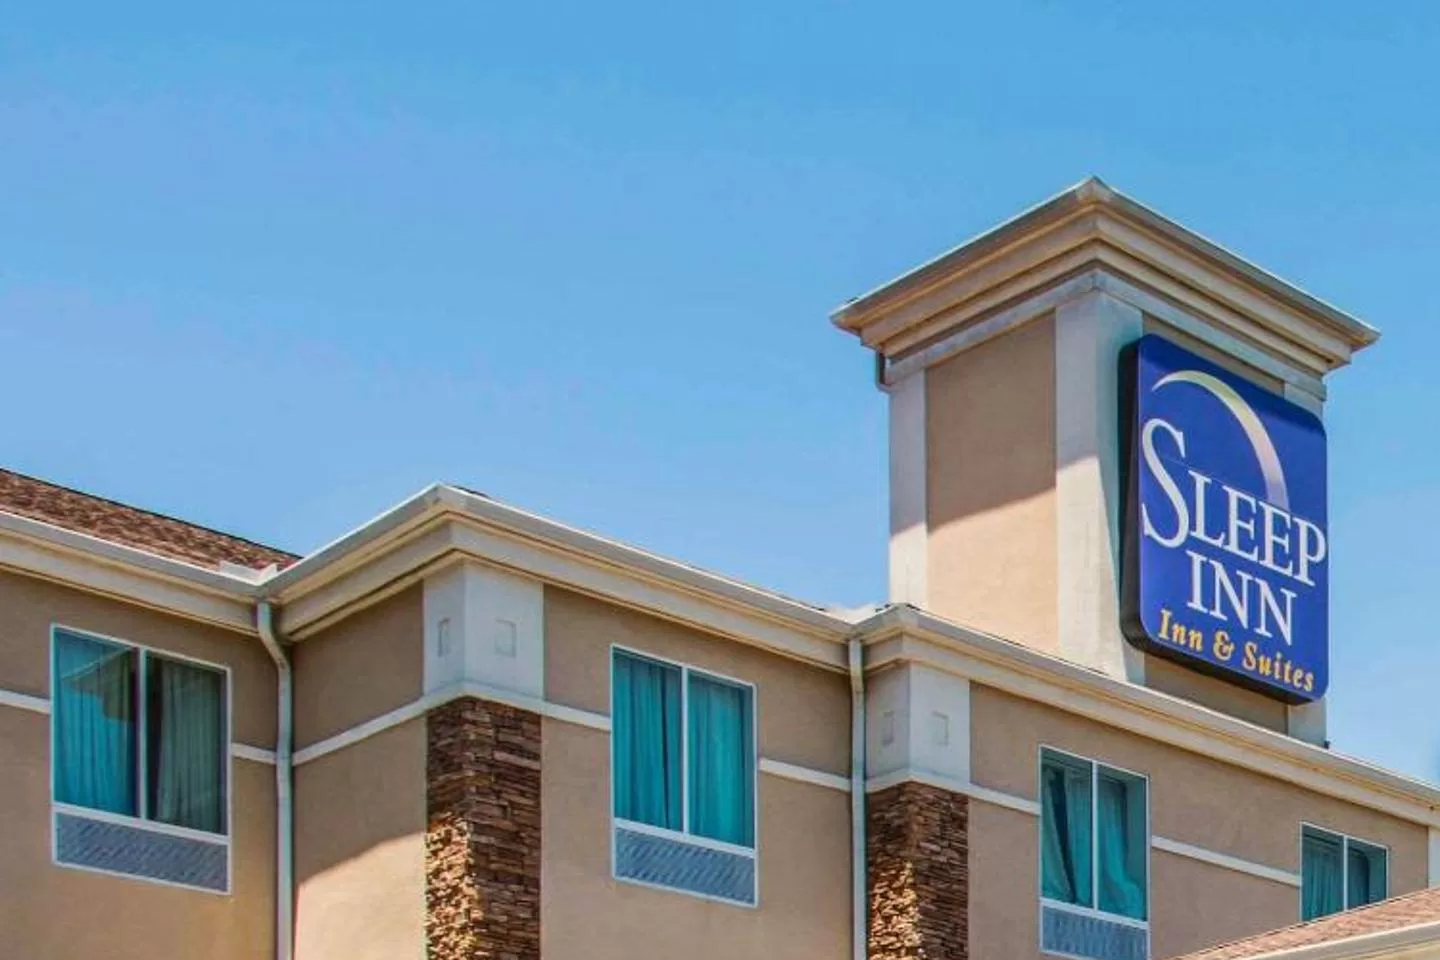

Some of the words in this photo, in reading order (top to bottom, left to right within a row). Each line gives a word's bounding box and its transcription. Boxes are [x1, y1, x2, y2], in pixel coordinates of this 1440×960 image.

[1142, 418, 1326, 587] SLEEP
[1186, 549, 1297, 646] INN
[1158, 608, 1203, 651] Inn
[1213, 630, 1236, 661] &
[1242, 641, 1314, 692] Suites
